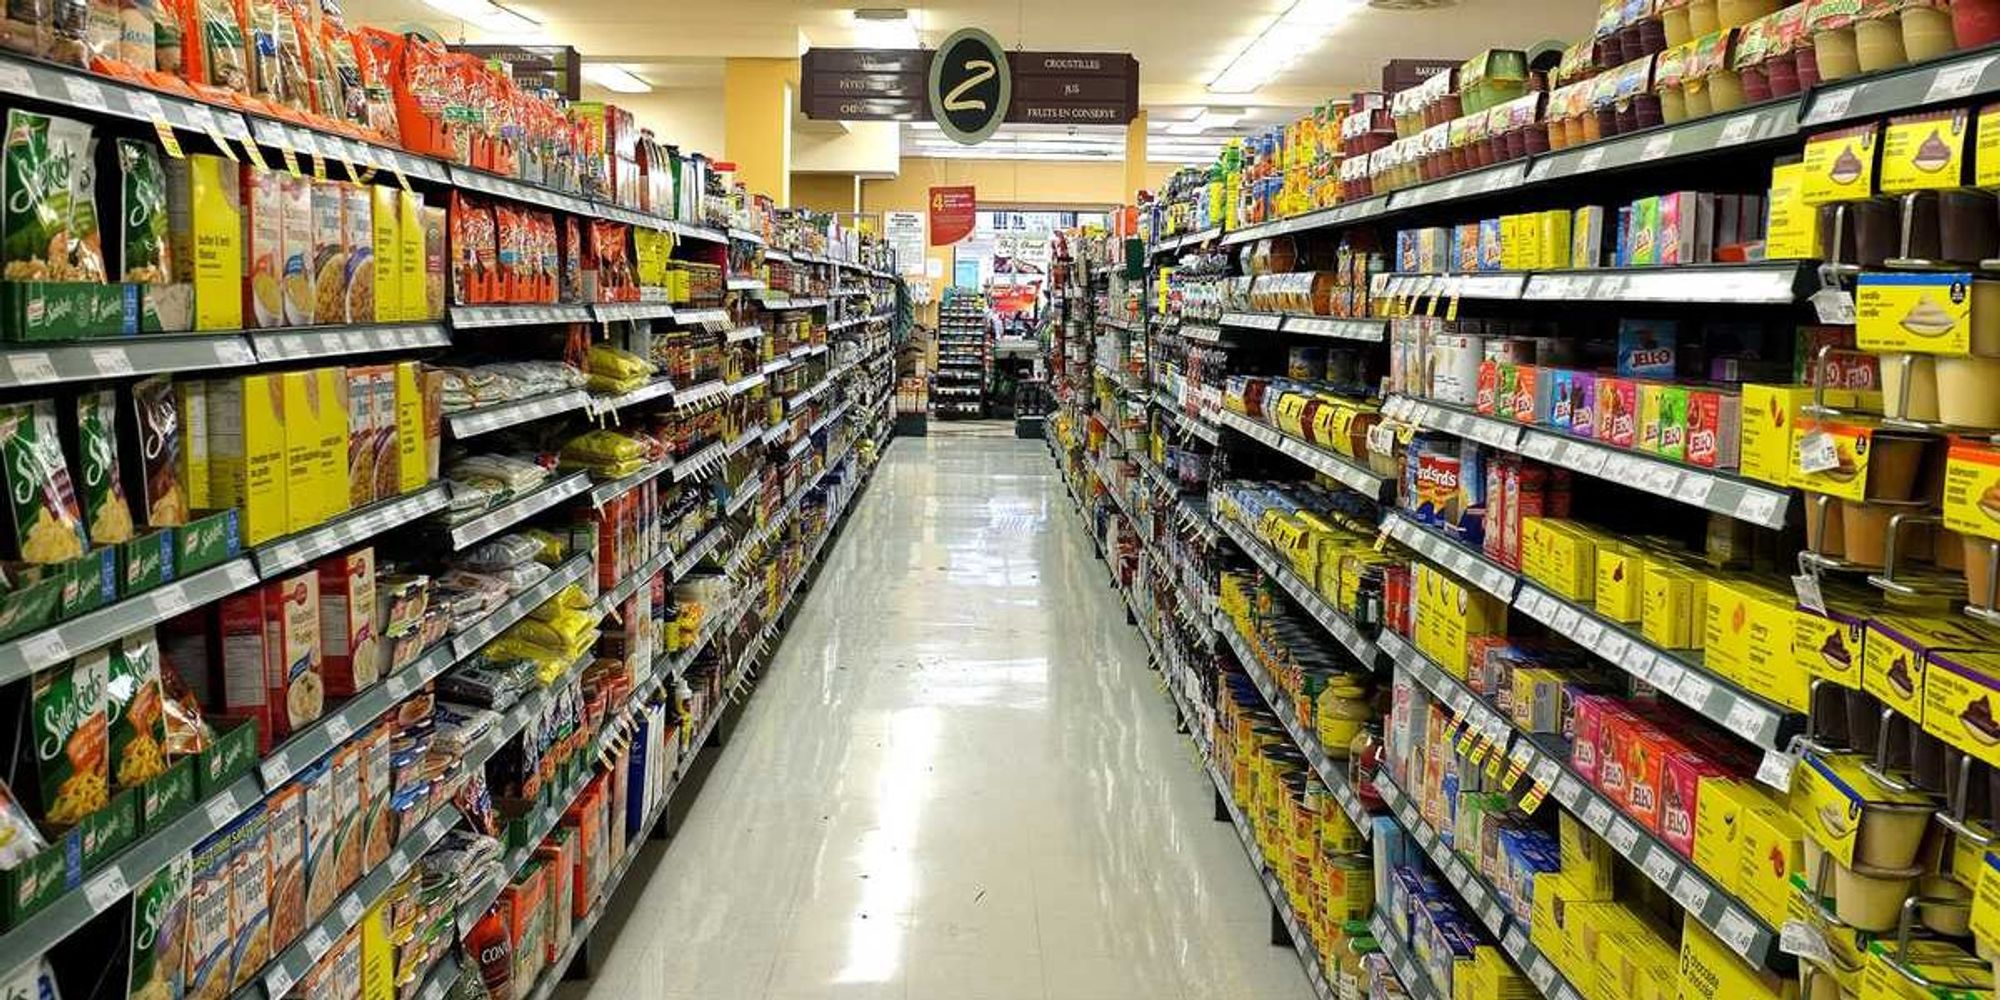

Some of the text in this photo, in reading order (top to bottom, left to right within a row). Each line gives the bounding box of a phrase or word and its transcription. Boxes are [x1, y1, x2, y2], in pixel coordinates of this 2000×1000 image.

[1044, 58, 1100, 70] CROUSTILLES
[943, 59, 997, 111] 2
[1064, 84, 1081, 96] JUS
[1027, 107, 1116, 119] FRUITS EN CONSERVE
[932, 193, 943, 211] 4
[1632, 349, 1671, 368] JELL-O
